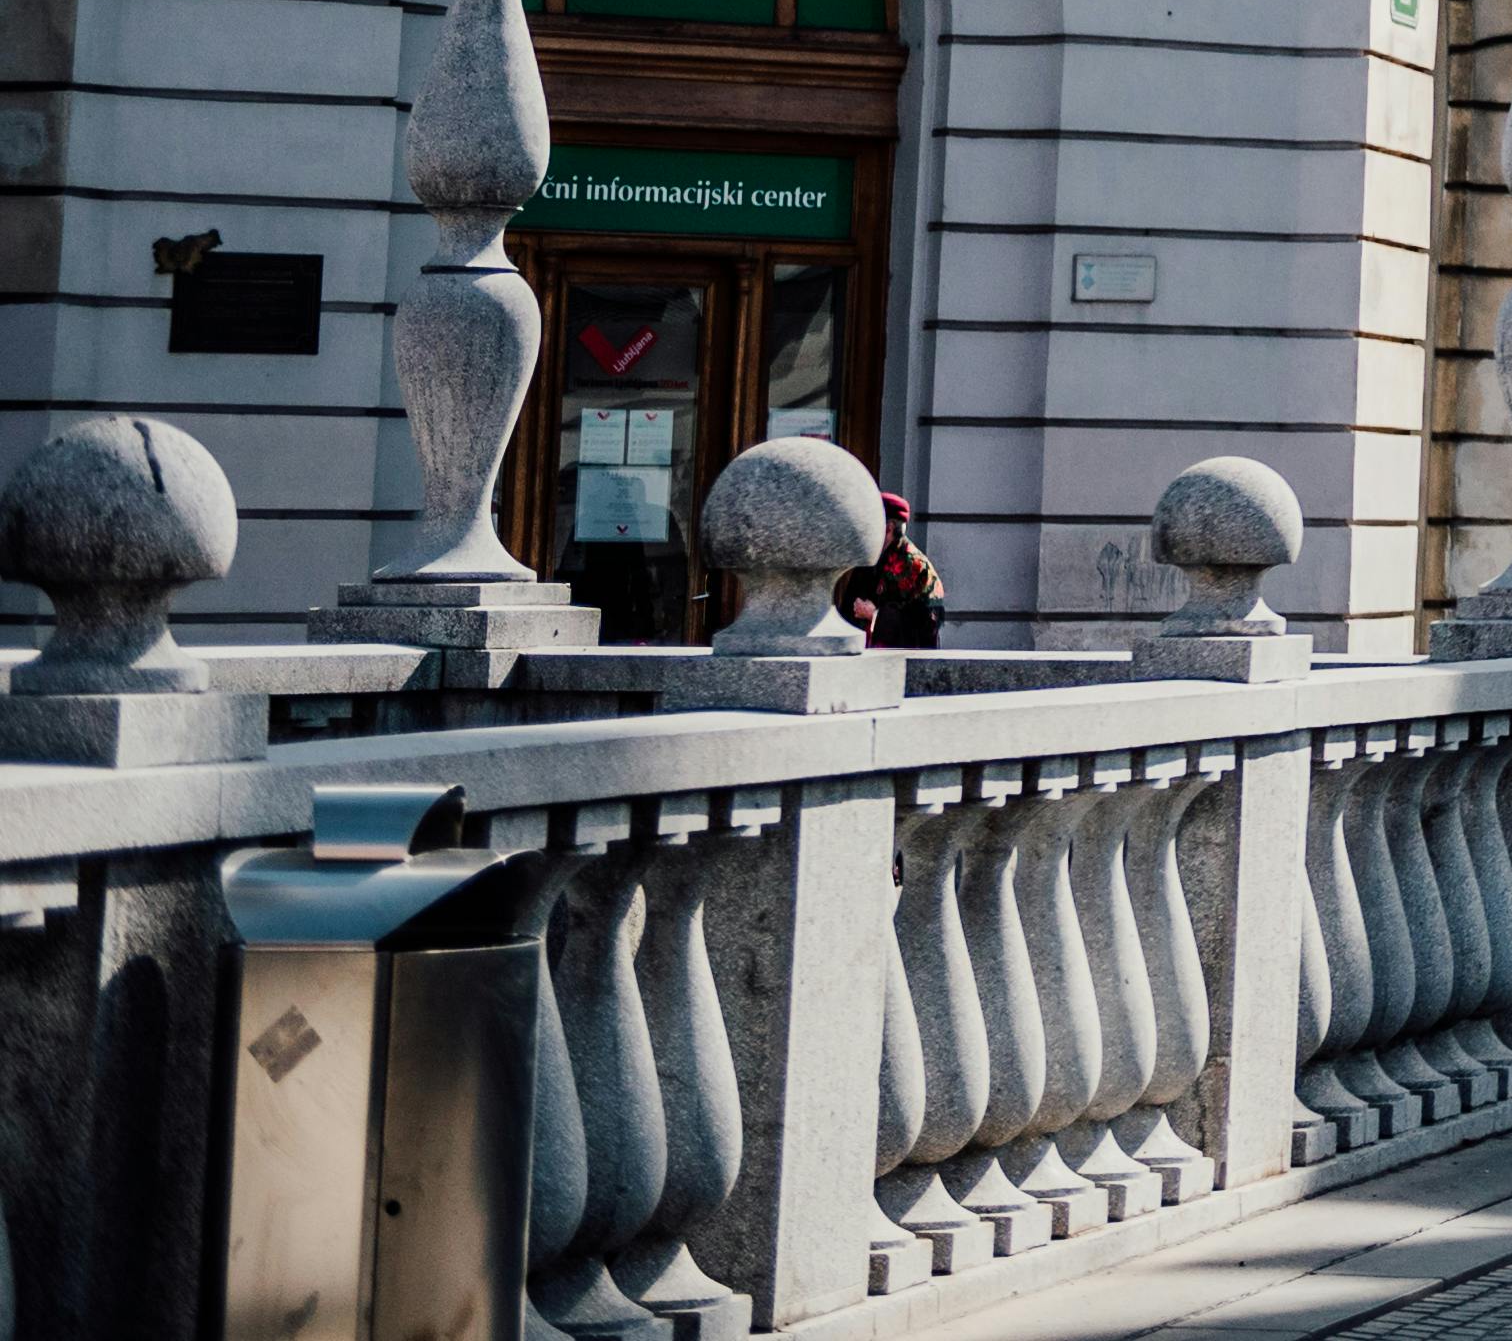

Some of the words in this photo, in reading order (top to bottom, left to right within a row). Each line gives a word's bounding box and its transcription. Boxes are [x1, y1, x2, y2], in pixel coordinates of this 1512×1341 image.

[541, 175, 578, 199] čni
[586, 176, 744, 210] informacijski
[750, 185, 827, 209] center
[613, 330, 654, 375] Ljubljana
